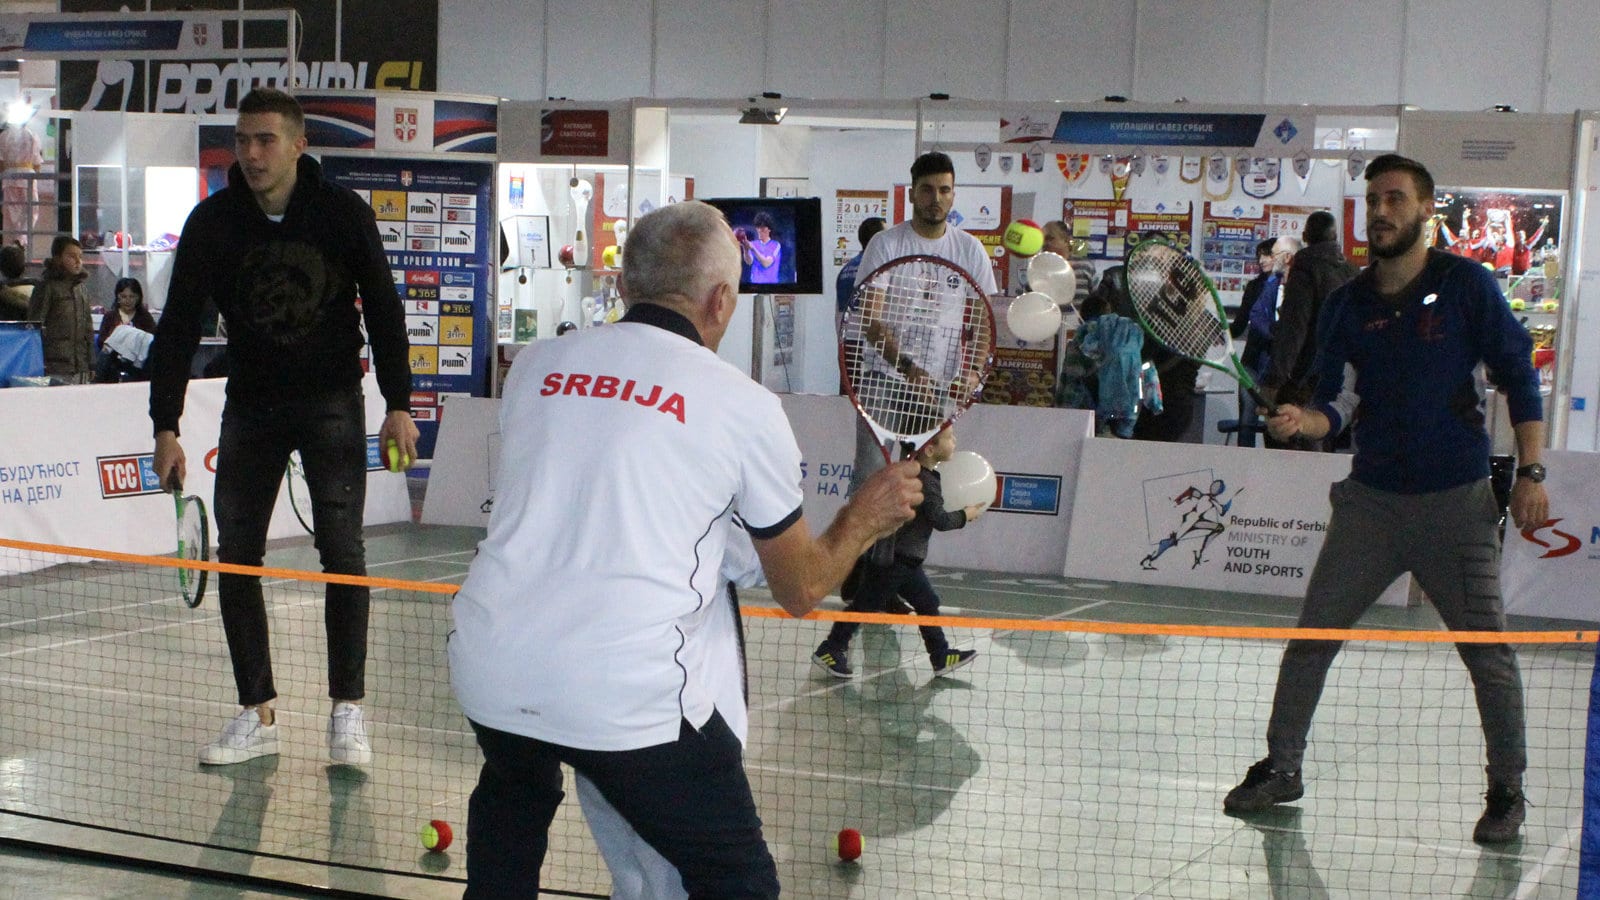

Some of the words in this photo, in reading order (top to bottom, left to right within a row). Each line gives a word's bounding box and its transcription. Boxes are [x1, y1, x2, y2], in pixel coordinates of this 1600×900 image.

[410, 205, 434, 213] PUMA
[844, 203, 880, 213] 2017
[444, 236, 468, 245] PUMA
[408, 328, 431, 337] PUMA
[441, 359, 464, 368] PUMA
[540, 372, 686, 424] SRBIJA
[0, 461, 80, 484] БУДУЋНОСТ
[2, 488, 23, 505] НА
[27, 484, 62, 505] ДЕЛУ
[817, 482, 839, 496] НА
[1230, 515, 1279, 529] Republic
[1282, 518, 1295, 529] of
[1228, 531, 1288, 546] MINISTRY
[1291, 536, 1309, 547] OF
[1226, 546, 1270, 560] YOUTH
[1224, 562, 1252, 574] AND
[1255, 564, 1304, 578] SPORTS
